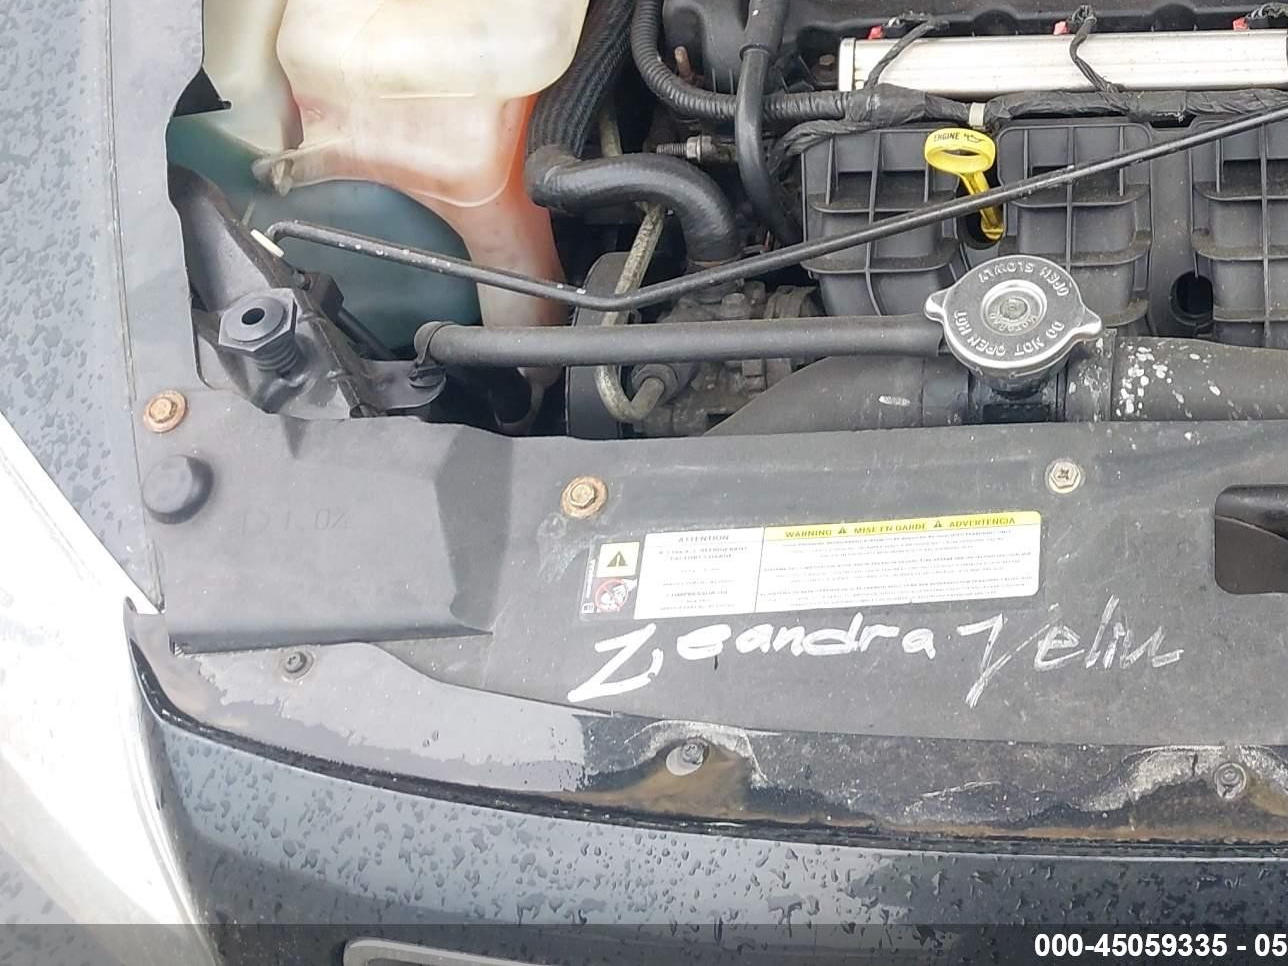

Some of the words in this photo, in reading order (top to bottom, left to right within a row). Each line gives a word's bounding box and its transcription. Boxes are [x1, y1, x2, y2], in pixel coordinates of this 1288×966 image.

[934, 132, 960, 142] ENGINE
[978, 261, 1035, 283] SLOWLY
[1039, 266, 1070, 296] OPEN
[1046, 321, 1065, 339] DO
[968, 335, 1006, 356] OPEN
[1014, 337, 1045, 356] NOT
[784, 529, 832, 538] WARNING
